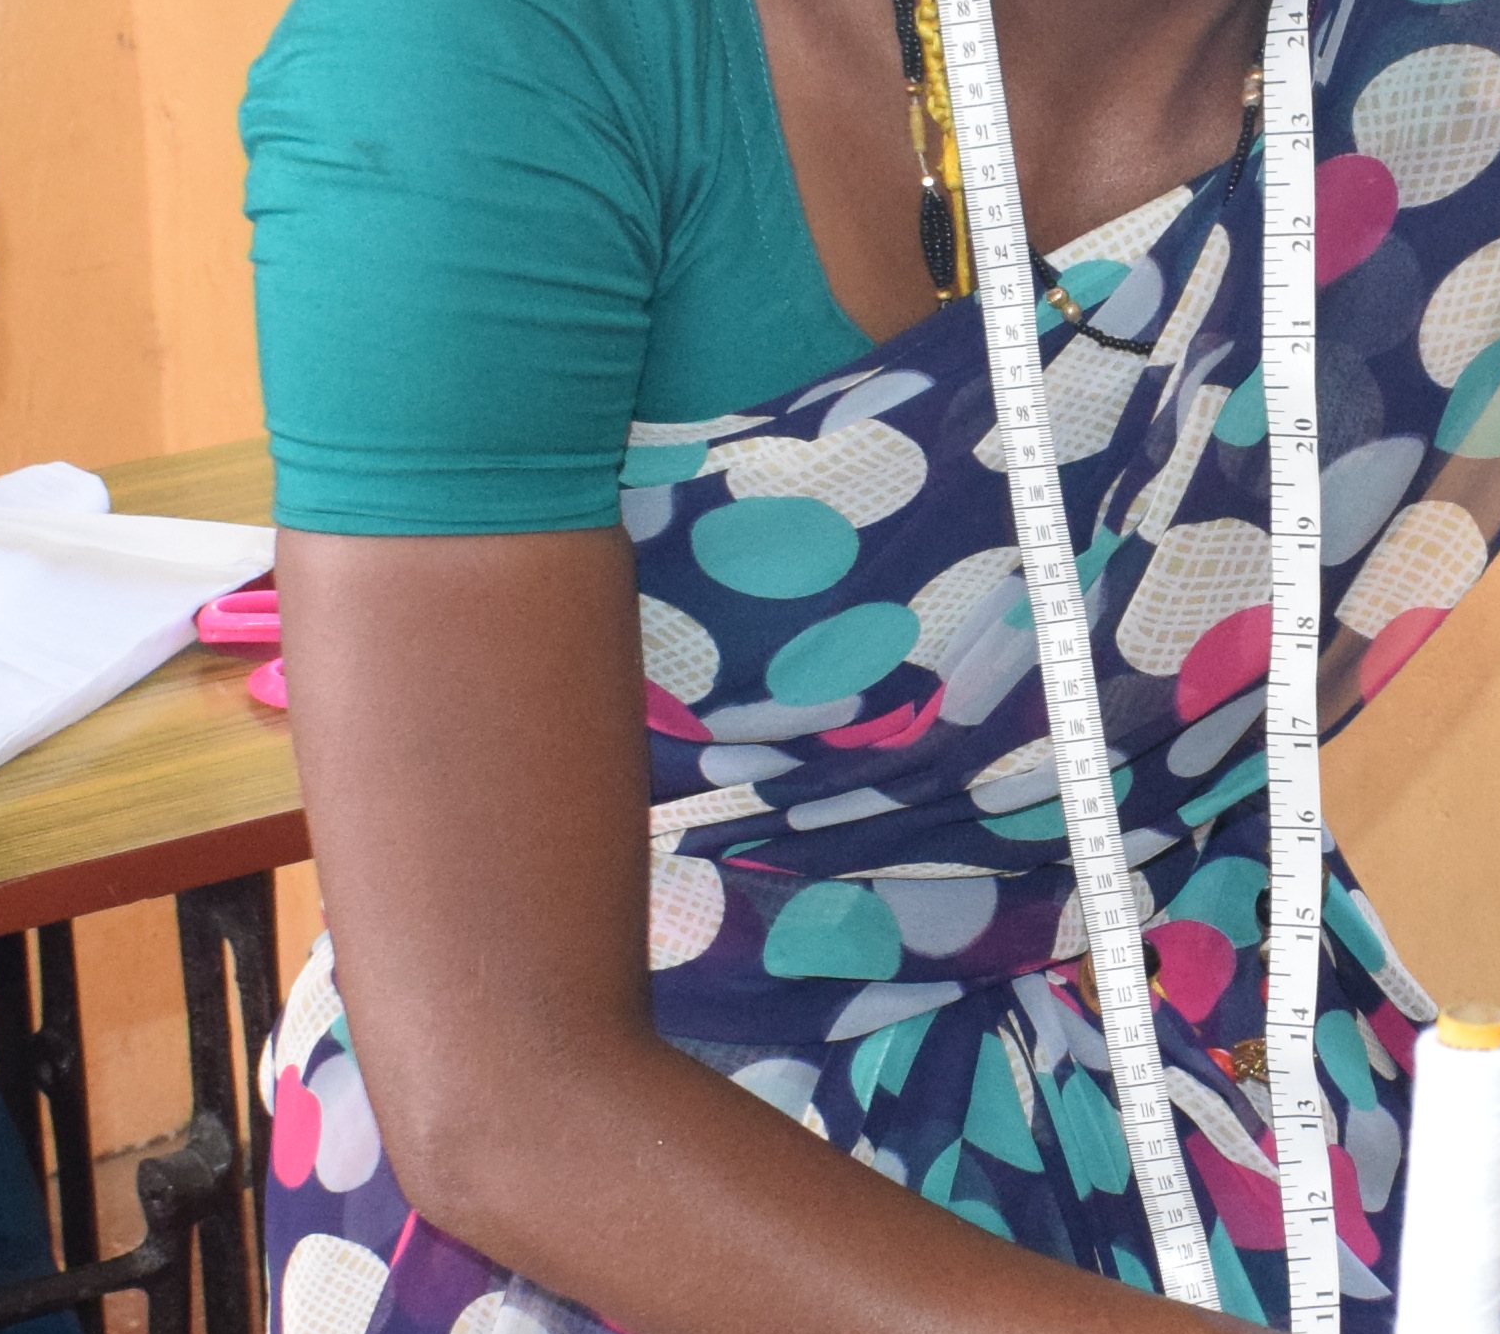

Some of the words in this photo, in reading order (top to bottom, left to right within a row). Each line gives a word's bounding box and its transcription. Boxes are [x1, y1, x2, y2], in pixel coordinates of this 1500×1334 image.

[957, 0, 971, 17] 88
[963, 41, 976, 58] 89
[969, 82, 983, 100] 90
[975, 124, 989, 140] 91
[981, 165, 996, 181] 92
[988, 204, 1003, 221] 93
[995, 244, 1009, 261] 94
[1000, 284, 1015, 300] 95
[1006, 324, 1019, 341] 96
[1010, 364, 1023, 382] 97
[1016, 406, 1030, 422] 98
[1023, 445, 1036, 462] 99
[1028, 485, 1045, 502] 100
[1035, 524, 1052, 542] 101
[1043, 562, 1061, 580] 102
[1051, 600, 1068, 617] 103
[1057, 638, 1074, 656] 104
[1063, 679, 1080, 696] 105
[1069, 718, 1086, 736] 106
[1075, 758, 1092, 775] 107
[1082, 797, 1099, 815] 108
[1089, 836, 1105, 853] 109
[1096, 873, 1113, 890] 110
[1103, 910, 1121, 927] 111
[1110, 946, 1127, 964] 112
[1116, 985, 1133, 1003] 113
[1123, 1024, 1140, 1042] 114
[1131, 1063, 1148, 1081] 115
[1139, 1102, 1156, 1119] 116
[1147, 1139, 1164, 1157] 117
[1156, 1173, 1174, 1191] 118
[1166, 1207, 1184, 1225] 119
[1176, 1243, 1194, 1260] 120
[1186, 1282, 1202, 1299] 121
